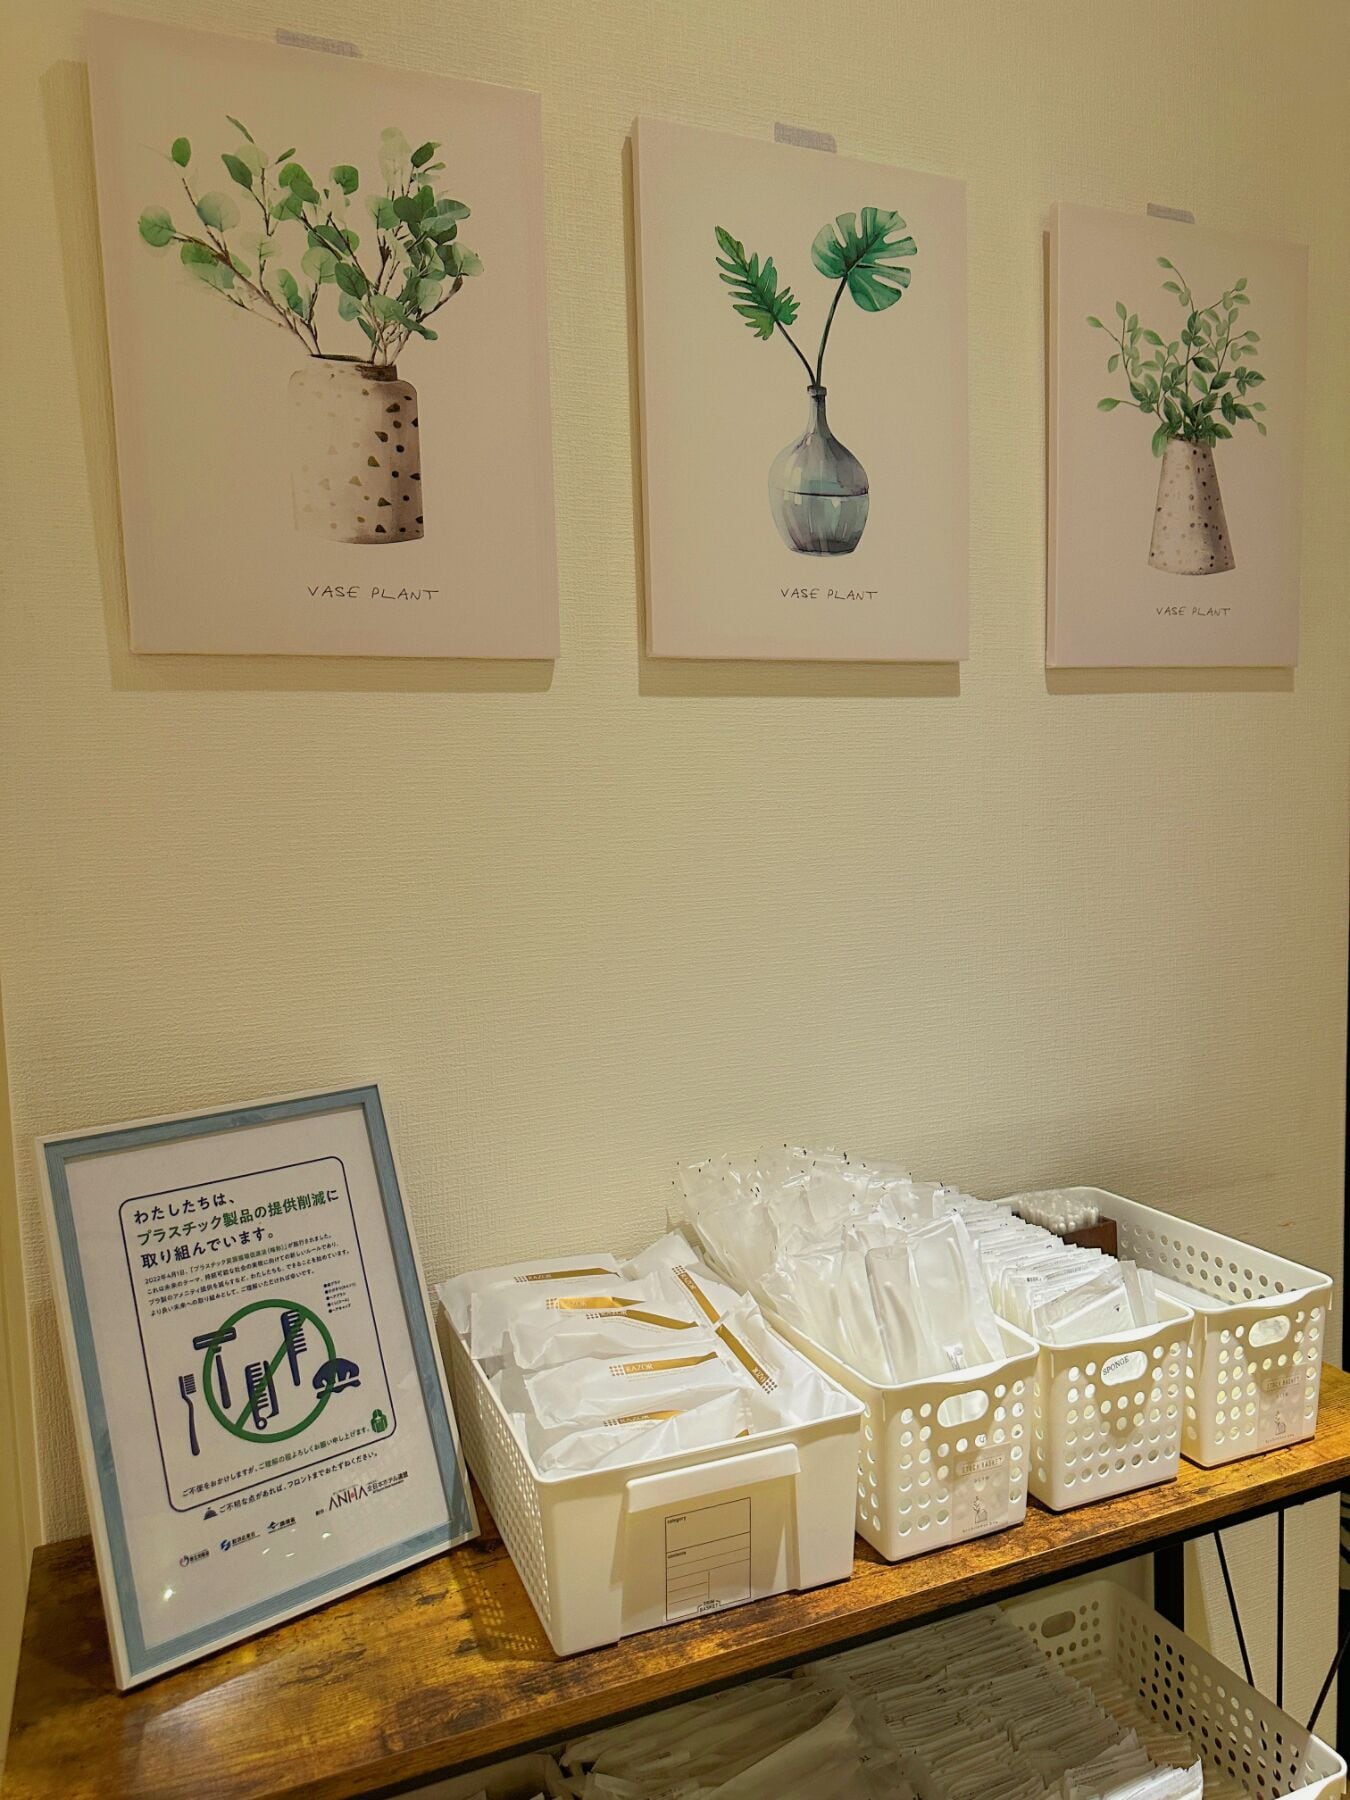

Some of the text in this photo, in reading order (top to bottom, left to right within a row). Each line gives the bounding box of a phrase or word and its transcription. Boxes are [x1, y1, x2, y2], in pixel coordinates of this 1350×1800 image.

[307, 585, 440, 601] VASE PLANT
[780, 587, 879, 601] VASE PLANT
[1156, 606, 1231, 617] VASE PLANT
[134, 1192, 235, 1225] わたしたちは、
[137, 1189, 340, 1246] プラスチック製品の提供削減に
[141, 1226, 275, 1269] 取り組んでいます。
[625, 1362, 654, 1373] RAZOR
